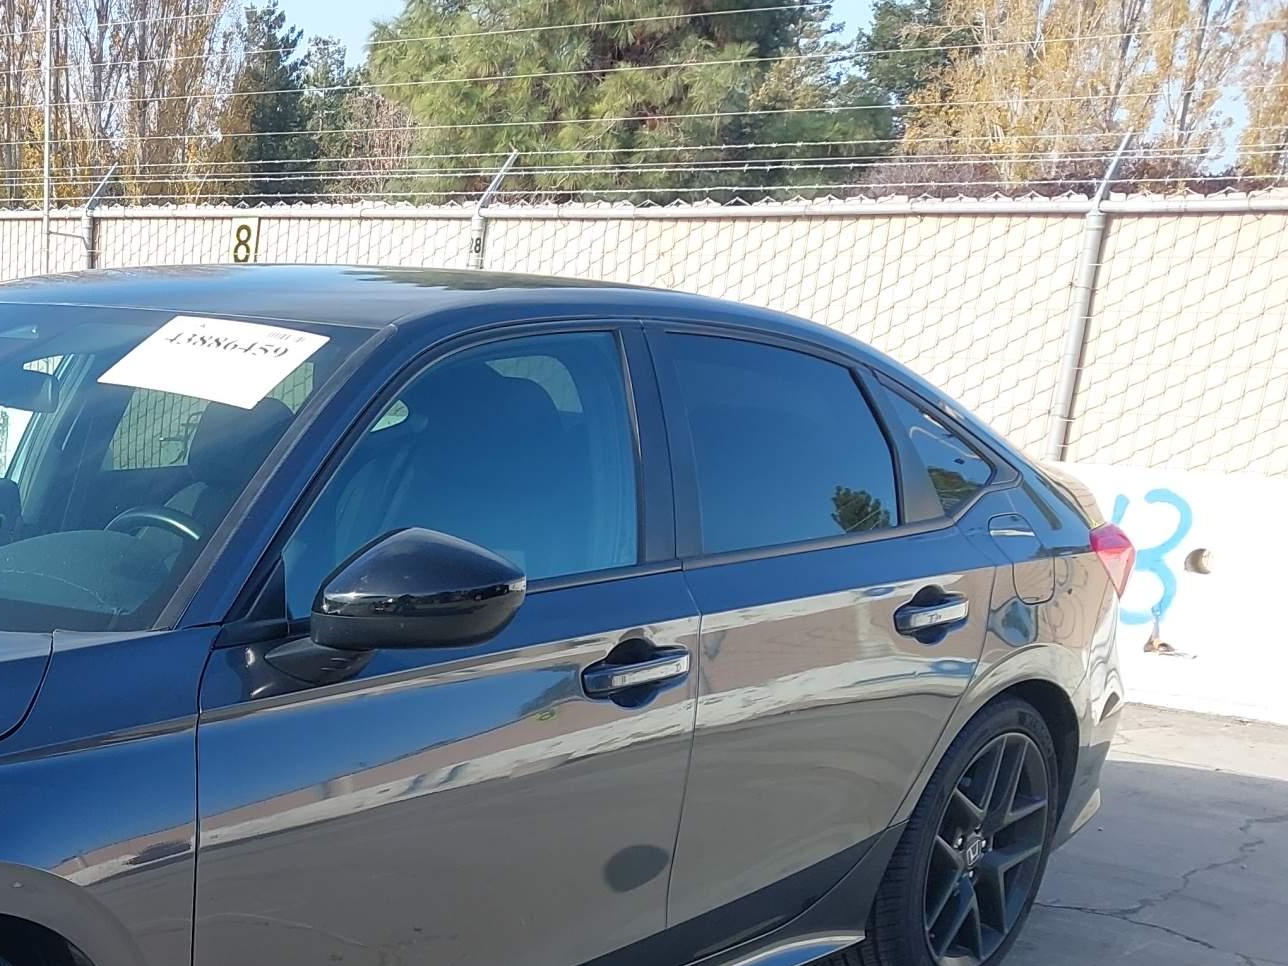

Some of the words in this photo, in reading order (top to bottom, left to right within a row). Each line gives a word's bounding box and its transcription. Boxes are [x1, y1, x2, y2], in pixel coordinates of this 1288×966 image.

[233, 223, 253, 263] 8
[165, 331, 289, 359] 43886459
[1111, 488, 1193, 626] 3
